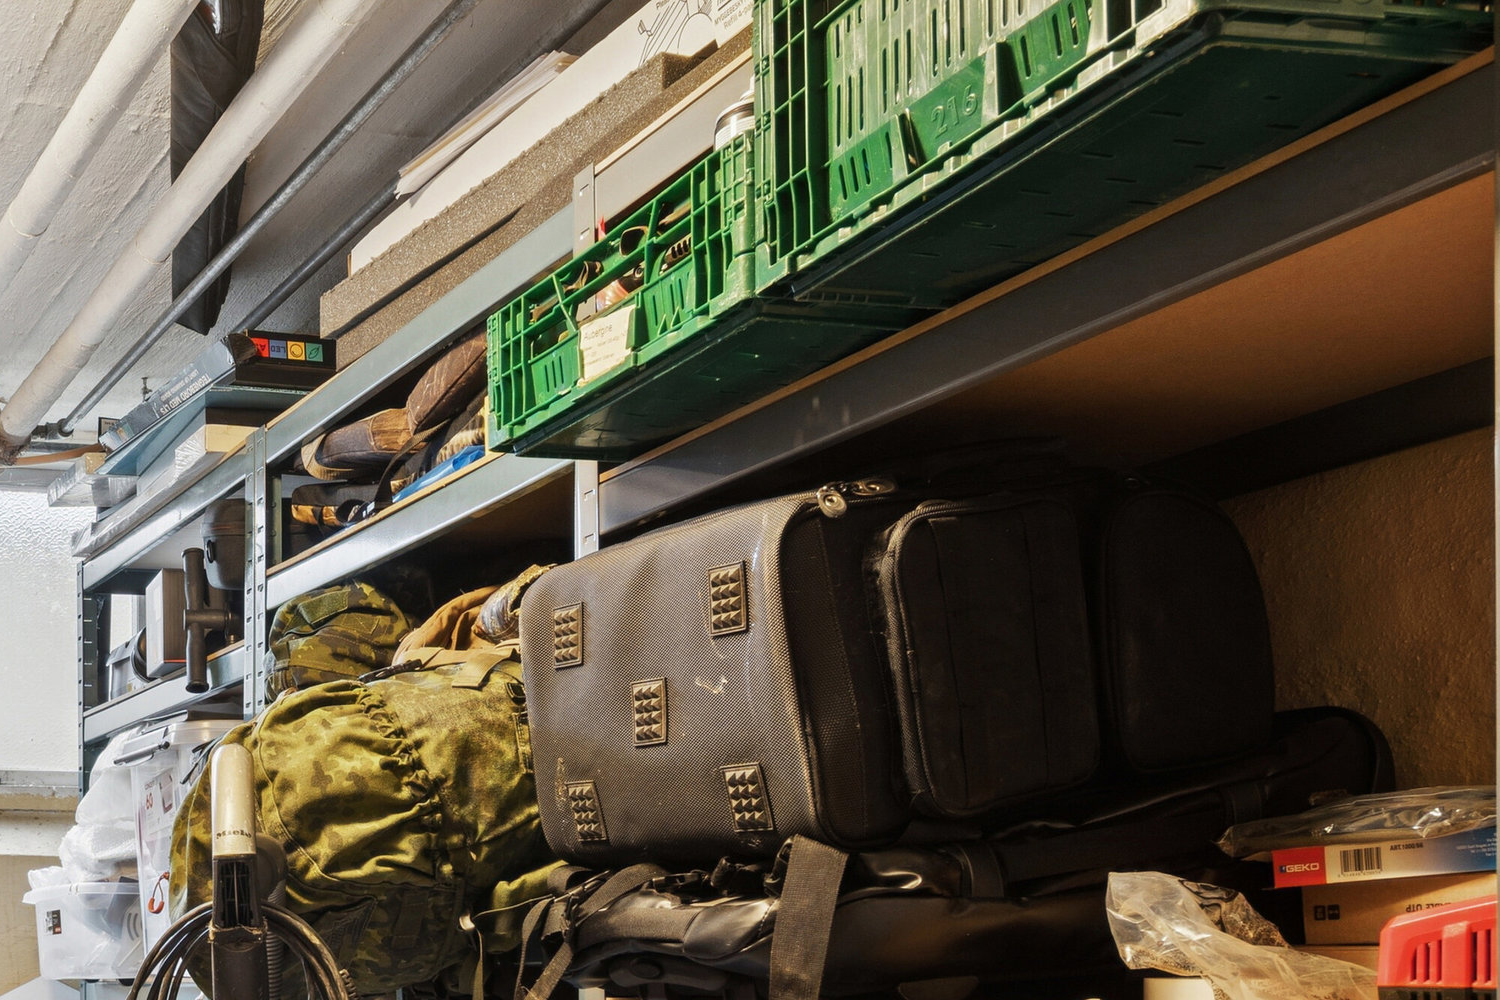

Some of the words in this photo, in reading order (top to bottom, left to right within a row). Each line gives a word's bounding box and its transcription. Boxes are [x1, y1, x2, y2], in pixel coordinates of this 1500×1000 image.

[930, 84, 979, 139] 216
[270, 345, 287, 353] LED
[1285, 862, 1320, 873] GEKO
[1405, 903, 1422, 913] UTP
